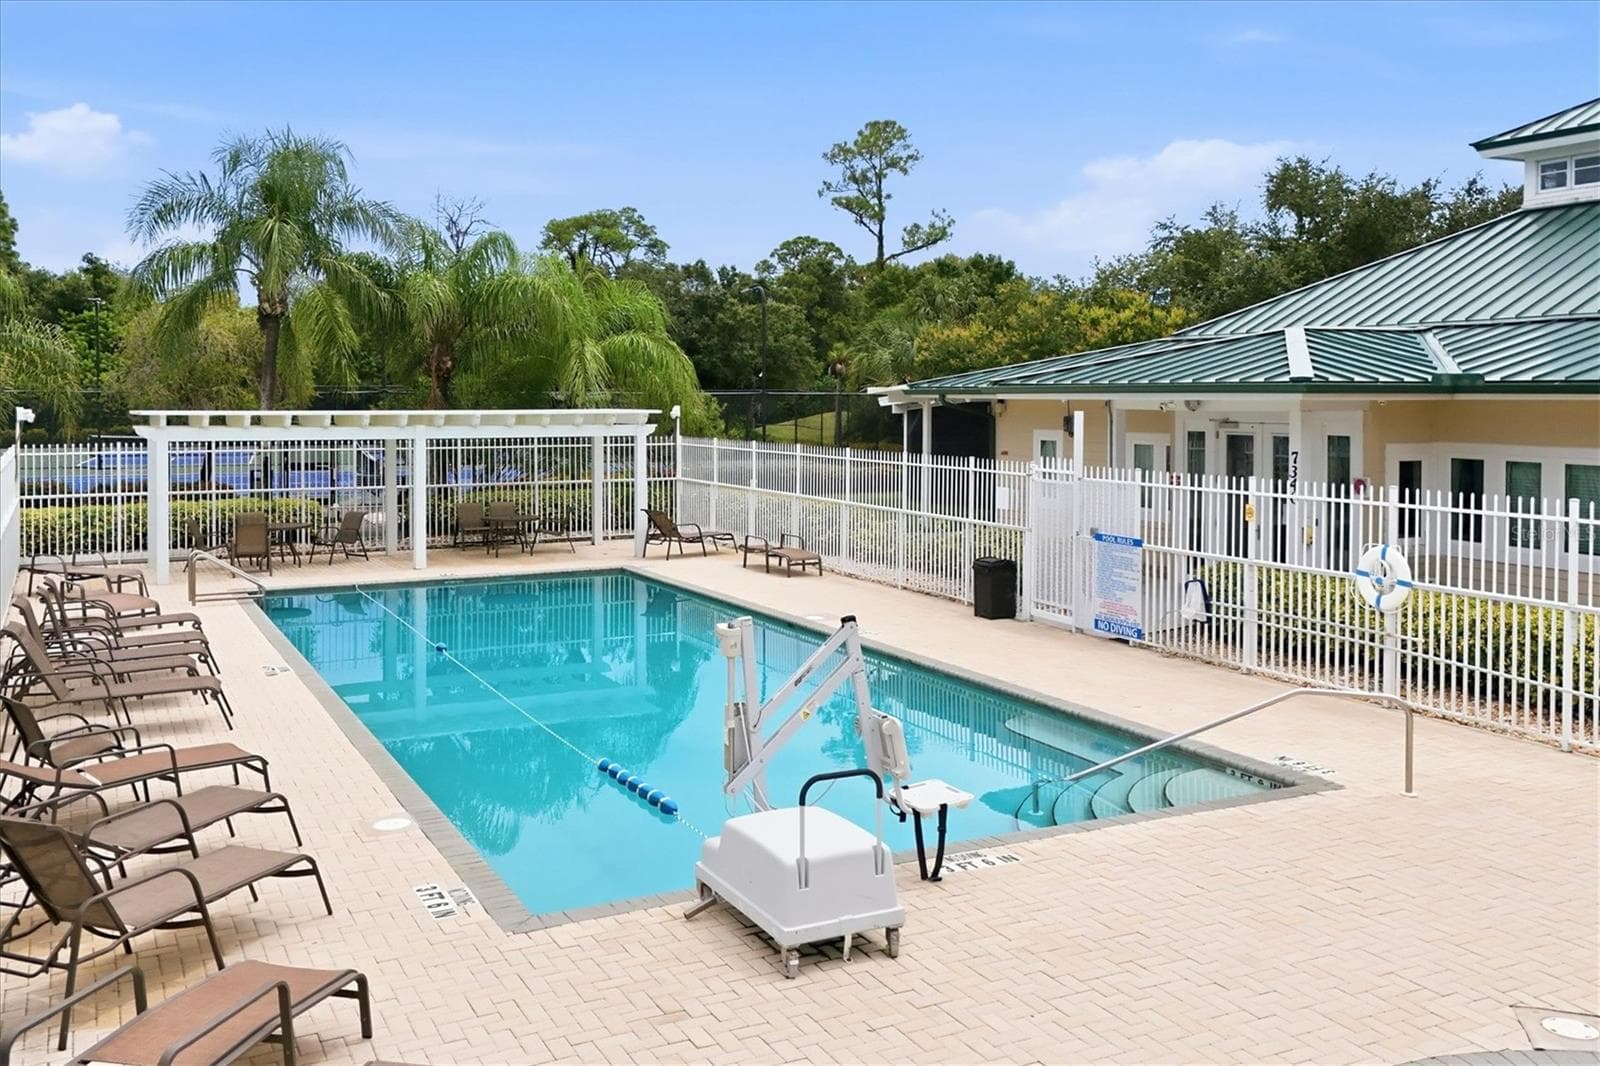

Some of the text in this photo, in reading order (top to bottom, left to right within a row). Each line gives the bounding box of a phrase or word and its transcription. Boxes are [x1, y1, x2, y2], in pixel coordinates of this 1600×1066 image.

[1102, 535, 1134, 546] POOL RULES
[1097, 620, 1138, 638] NO DIVING
[956, 861, 978, 871] FT
[996, 854, 1020, 863] IN
[419, 892, 445, 902] FT
[431, 908, 457, 919] IN
